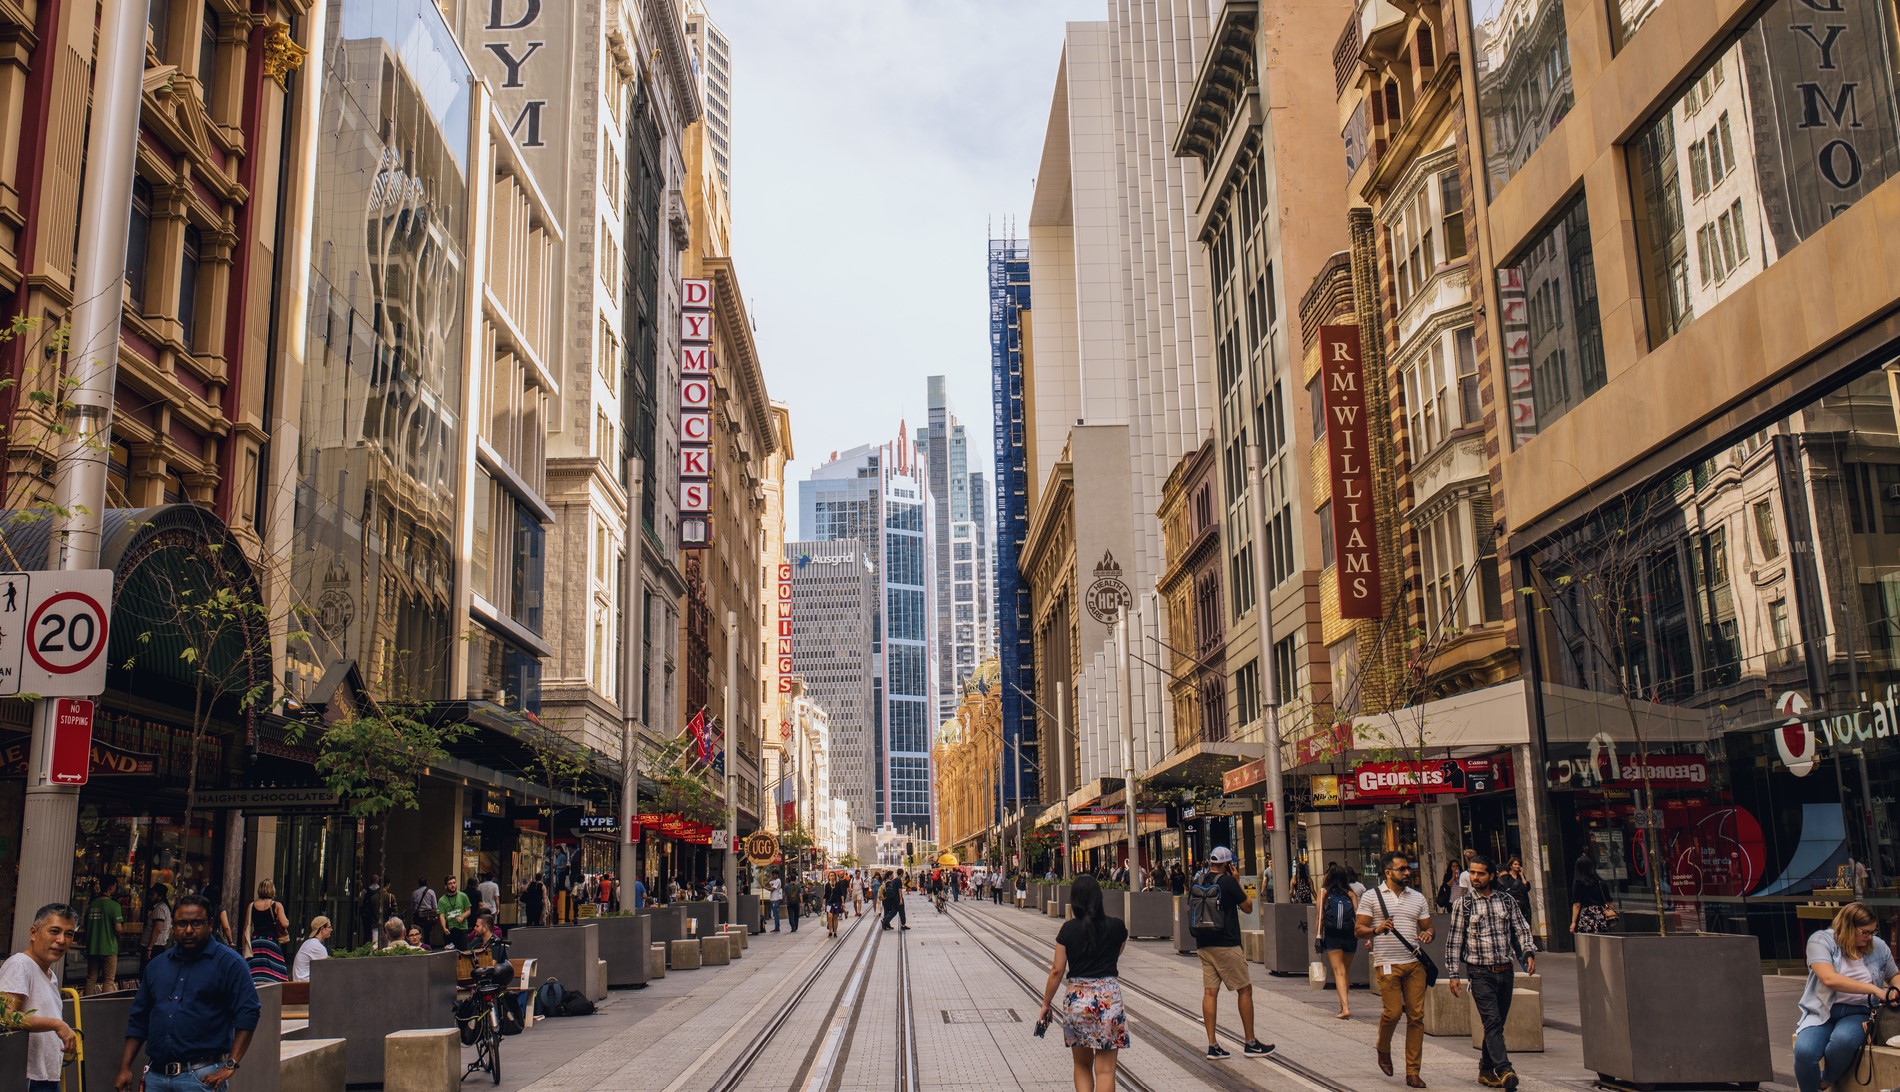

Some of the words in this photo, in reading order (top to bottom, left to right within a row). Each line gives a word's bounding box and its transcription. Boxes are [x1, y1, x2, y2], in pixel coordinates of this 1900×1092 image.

[683, 282, 708, 508] DYMOCKS
[811, 552, 855, 568] Ausgrid
[1093, 580, 1123, 591] HEALTH
[1088, 600, 1104, 620] CARE
[38, 613, 95, 652] 20
[779, 565, 791, 692] GOWINGS
[70, 704, 81, 714] NO
[60, 715, 89, 726] STOPPING
[198, 794, 247, 803] HAIGH'S
[251, 792, 334, 802] CHOCOLATES
[580, 817, 614, 826] HYPE
[752, 839, 772, 855] UGG
